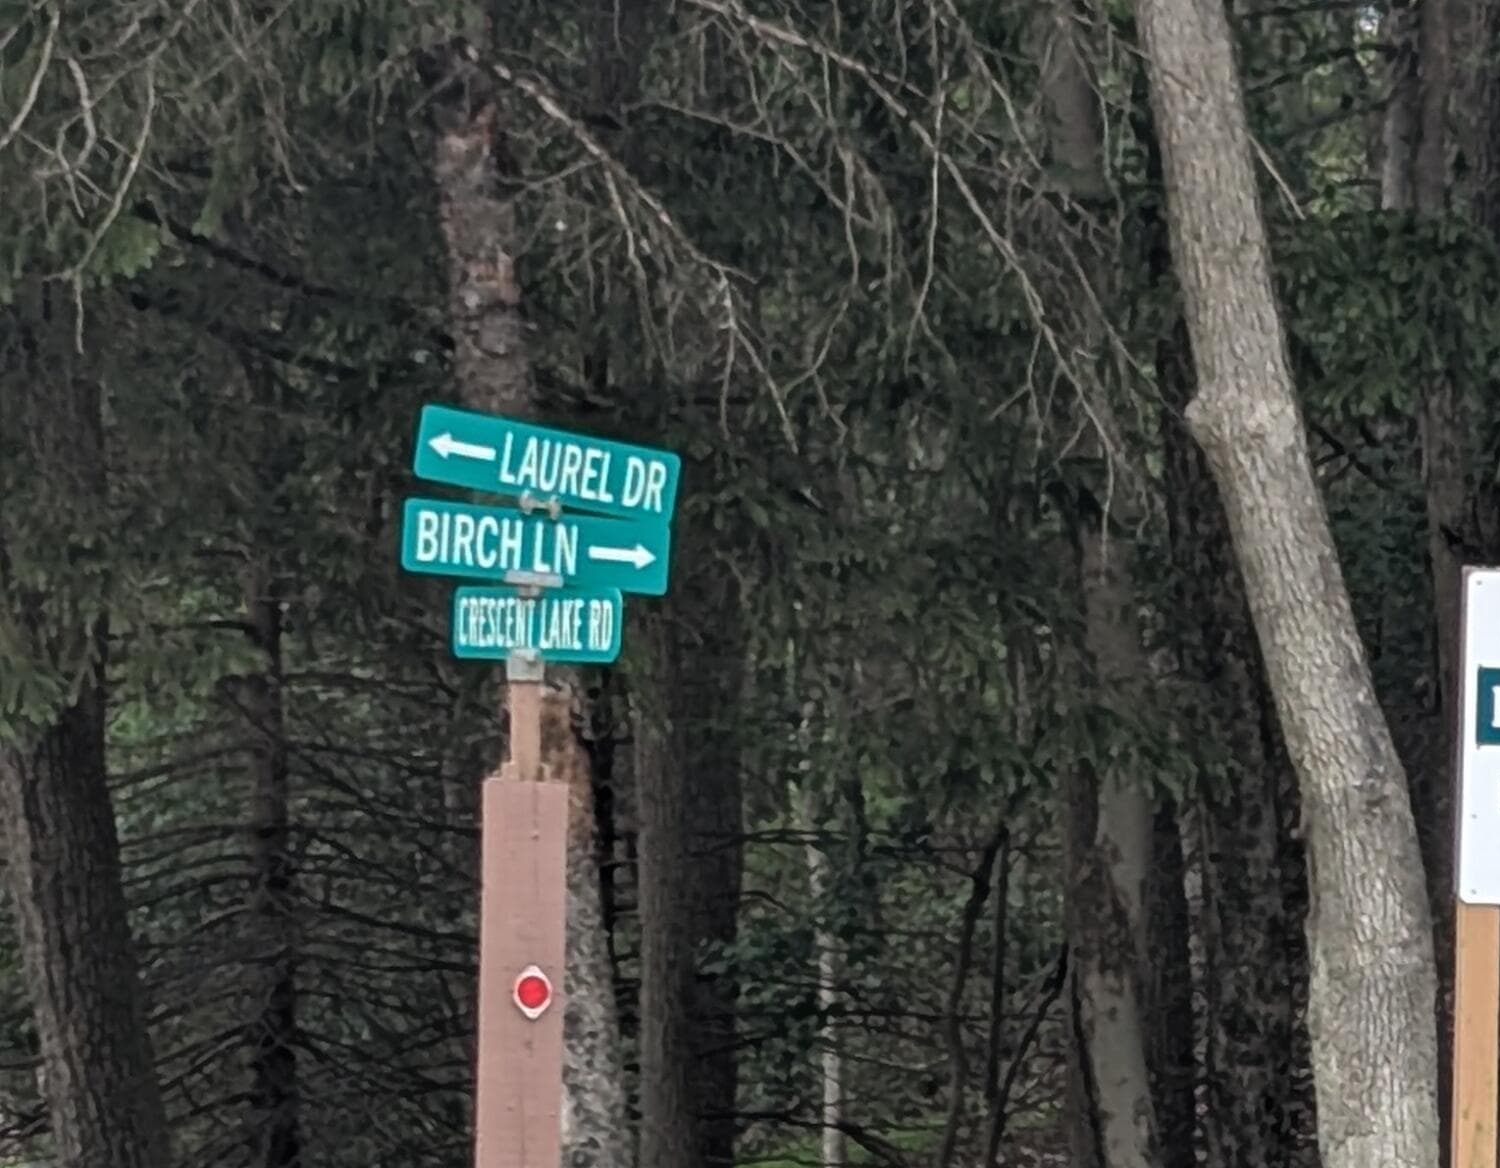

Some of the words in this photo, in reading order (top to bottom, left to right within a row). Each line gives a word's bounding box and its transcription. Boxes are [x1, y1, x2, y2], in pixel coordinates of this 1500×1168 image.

[499, 431, 613, 503] LAUREL
[621, 456, 667, 512] DR
[416, 510, 523, 570] BIRCH
[533, 522, 578, 575] LN
[459, 597, 535, 648] CRESCENT
[539, 598, 584, 650] LAKE
[589, 599, 613, 651] RD
